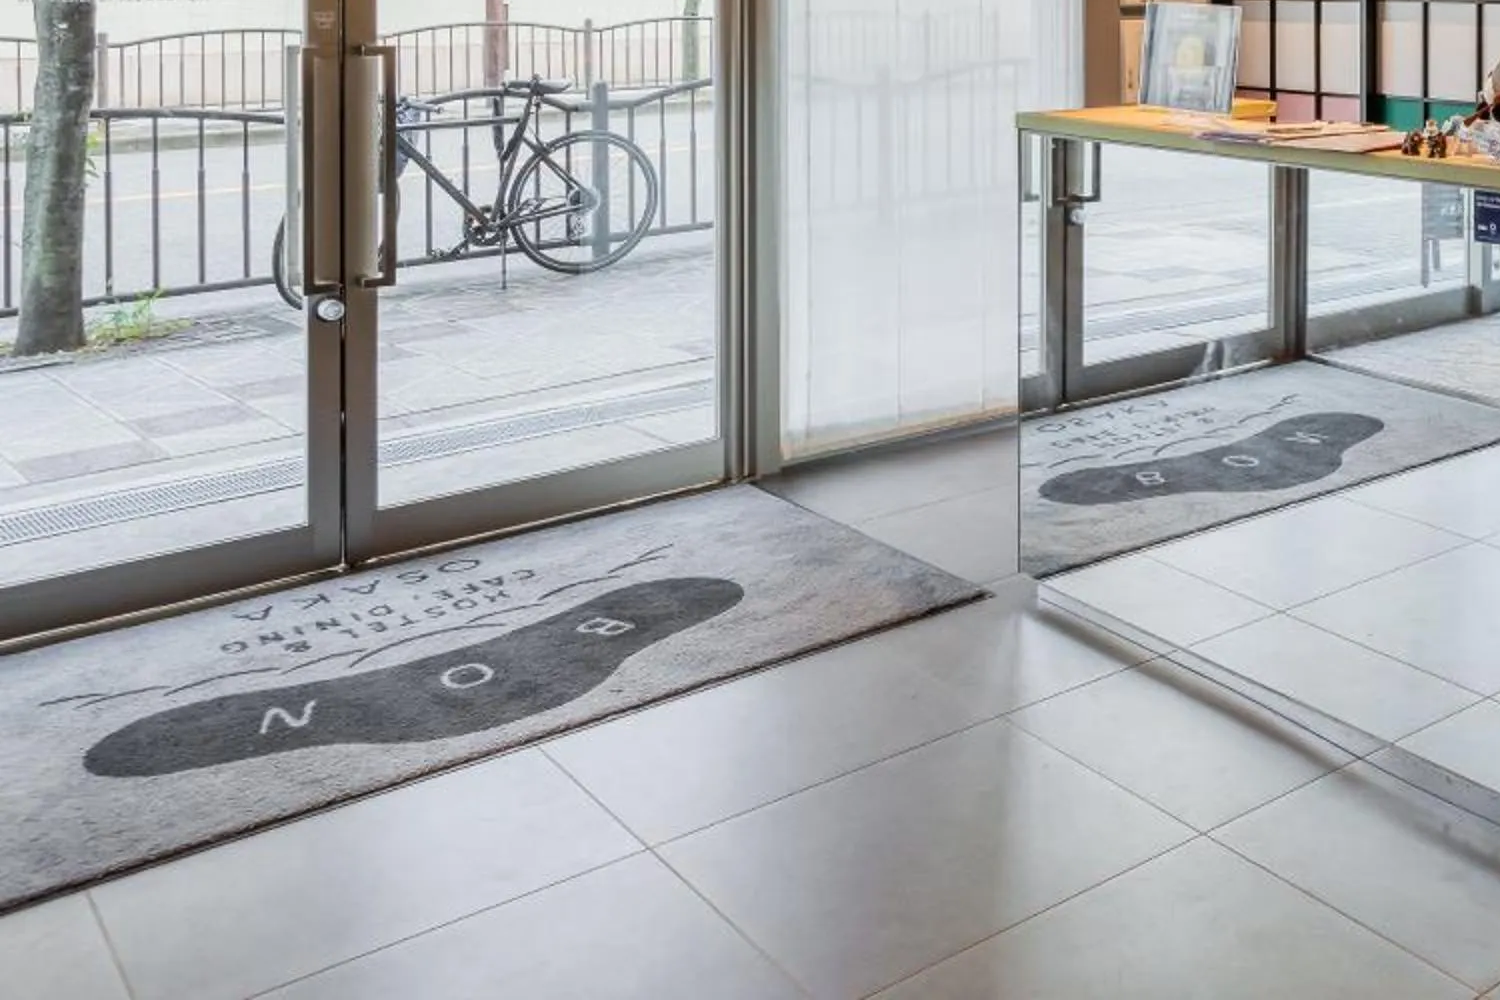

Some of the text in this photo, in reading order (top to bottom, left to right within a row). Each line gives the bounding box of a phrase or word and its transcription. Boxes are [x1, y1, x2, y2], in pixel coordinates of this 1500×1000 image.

[232, 558, 482, 622] OSAKA
[339, 589, 511, 639] HOSTEL
[220, 603, 396, 653] DINING
